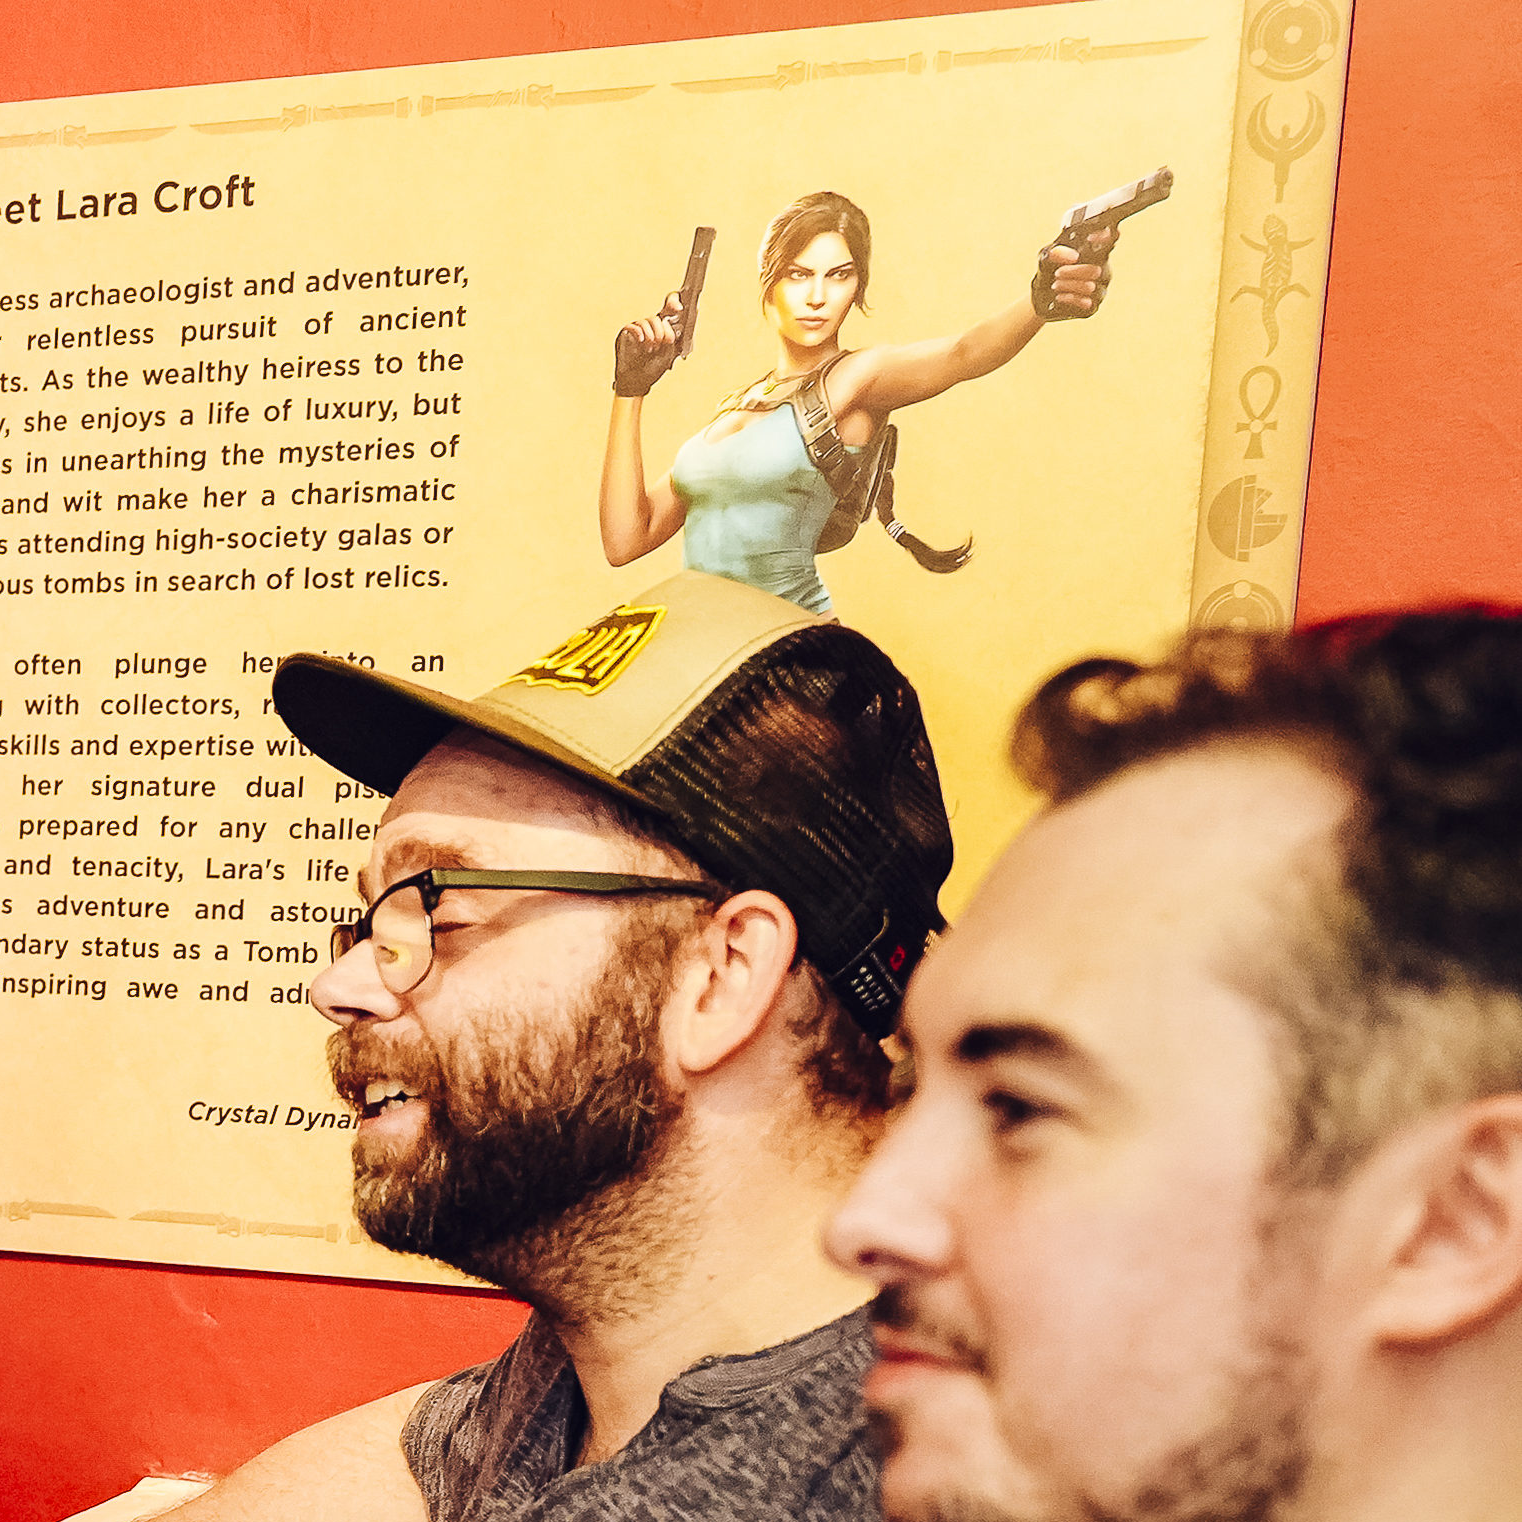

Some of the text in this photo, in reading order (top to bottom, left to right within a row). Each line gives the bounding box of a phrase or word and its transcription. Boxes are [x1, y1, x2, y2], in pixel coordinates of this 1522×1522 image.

[56, 189, 138, 221] Lara
[153, 173, 256, 214] Croft
[49, 276, 234, 309] archaeologist
[243, 270, 295, 297] and
[305, 265, 469, 293] adventurer,
[26, 324, 155, 351] relentless
[180, 315, 278, 348] pursuit
[304, 310, 334, 336] of
[359, 305, 467, 333] ancient
[41, 369, 74, 392] As
[86, 365, 129, 389] the
[142, 359, 249, 387] wealthy
[262, 355, 361, 381] heiress
[374, 352, 404, 375] to
[417, 348, 464, 373] the
[23, 410, 68, 433] she
[80, 406, 166, 434] enjoys
[179, 408, 194, 426] a
[208, 400, 250, 425] life
[263, 398, 293, 423] of
[305, 397, 398, 423] luxury,
[413, 392, 462, 416] but
[17, 530, 145, 556] attending
[155, 525, 328, 555] high-society
[337, 522, 412, 551] galas
[423, 526, 455, 545] or
[43, 571, 126, 595] tombs
[135, 570, 158, 593] in
[167, 567, 256, 592] search
[266, 566, 295, 591] of
[303, 566, 355, 590] lost
[365, 564, 449, 589] relics.
[13, 653, 82, 676] often
[114, 652, 208, 680] plunge
[411, 654, 445, 673] an
[24, 693, 80, 716] with
[100, 693, 240, 720] collectors,
[70, 733, 119, 756] and
[129, 733, 255, 761] expertise
[21, 773, 64, 796] her
[90, 774, 217, 801] signature
[245, 775, 304, 799] dual
[19, 814, 139, 841] prepared
[159, 815, 198, 838] for
[218, 821, 268, 844] any
[289, 817, 379, 841] challe
[3, 853, 52, 876] and
[71, 855, 184, 883] tenacity,
[205, 857, 285, 881] Lara's
[307, 858, 350, 883] life
[36, 894, 170, 919] adventure
[194, 898, 245, 921] and
[270, 900, 363, 925] astoun
[126, 981, 179, 1000] awe
[198, 980, 249, 1003] and
[188, 1100, 359, 1132] Crystal Dyna
